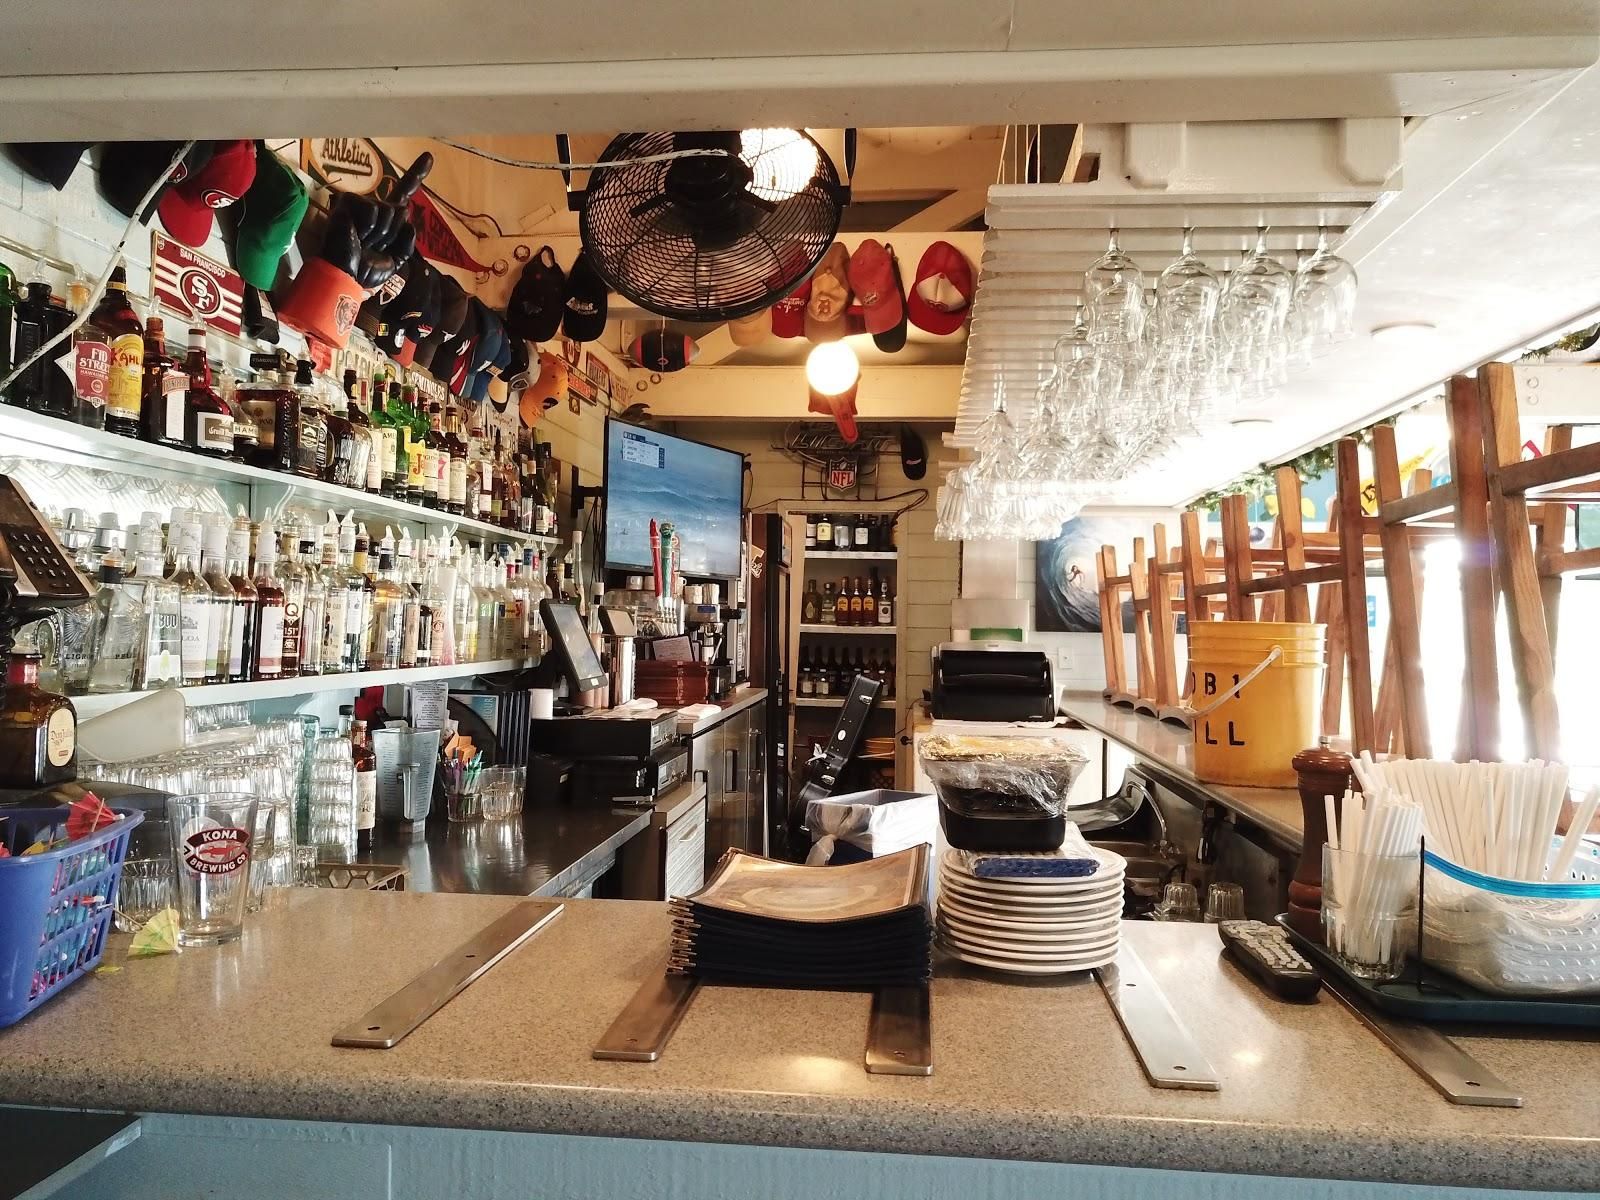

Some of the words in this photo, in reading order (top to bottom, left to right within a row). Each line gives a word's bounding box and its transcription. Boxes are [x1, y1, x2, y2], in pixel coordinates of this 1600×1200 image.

[322, 137, 371, 168] Athletics
[179, 247, 193, 262] SAN
[193, 255, 227, 279] FRANCISCO
[832, 472, 853, 486] NFL
[285, 602, 299, 617] Q
[202, 830, 238, 842] KONA
[189, 857, 236, 873] BREWING
